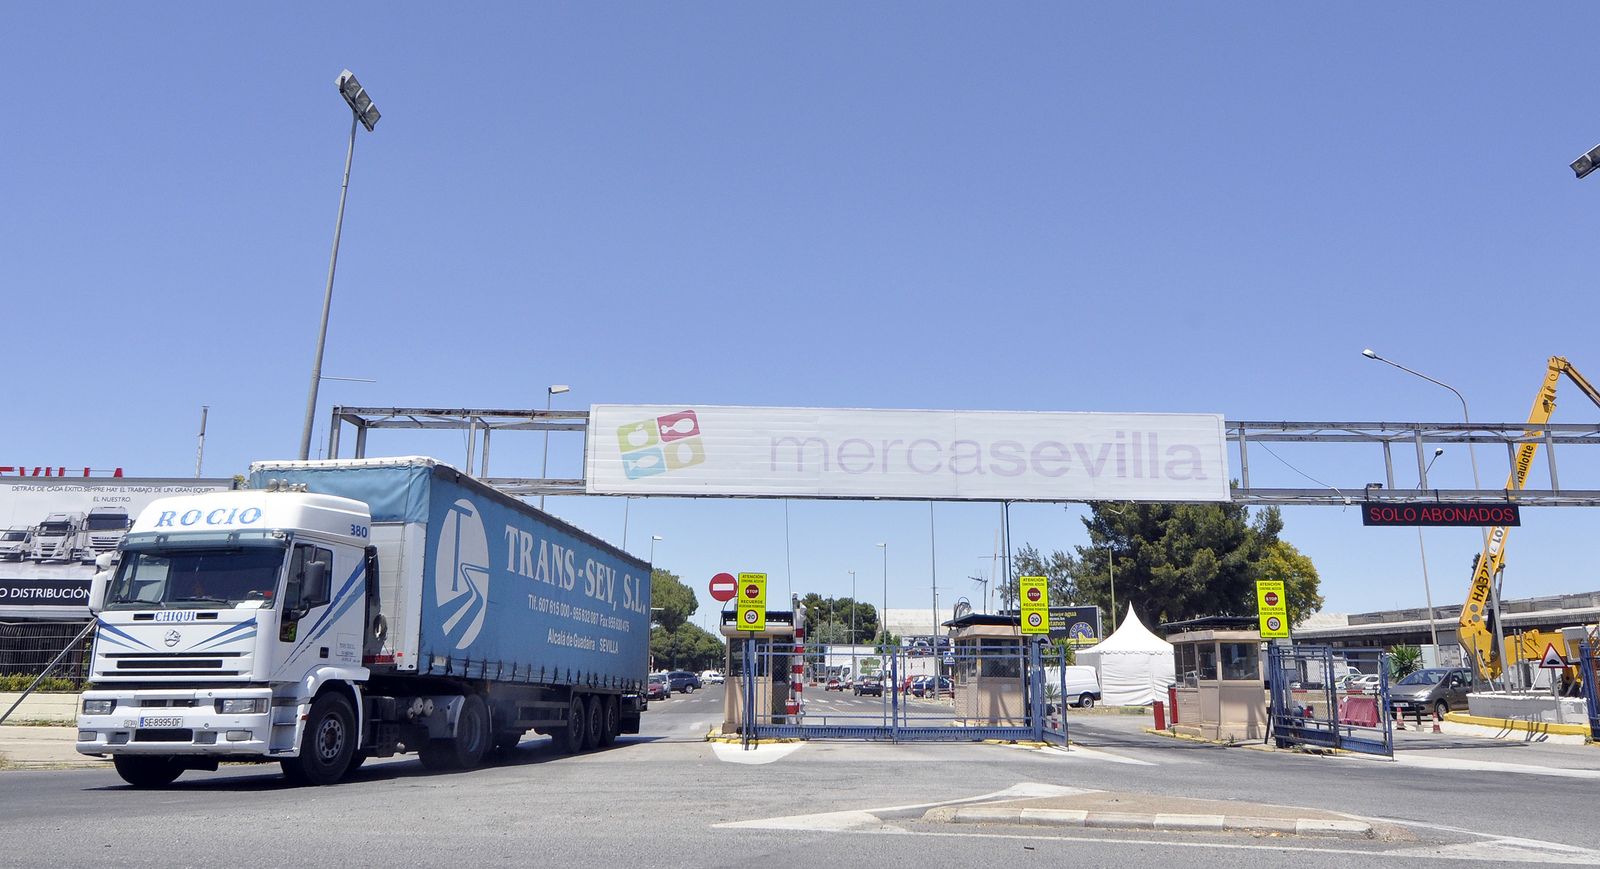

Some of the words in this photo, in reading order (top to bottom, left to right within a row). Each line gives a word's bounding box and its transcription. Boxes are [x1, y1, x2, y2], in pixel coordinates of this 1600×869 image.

[770, 431, 1208, 480] mercasevilla
[154, 508, 262, 528] ROCIO
[1370, 508, 1417, 522] SOLO
[1421, 508, 1514, 522] ABONADOS
[351, 524, 368, 538] 380
[10, 586, 91, 598] DISTRIBUCIÓN
[539, 597, 549, 613] 607
[155, 612, 195, 622] CHIQUI
[600, 638, 618, 654] SEVILLA
